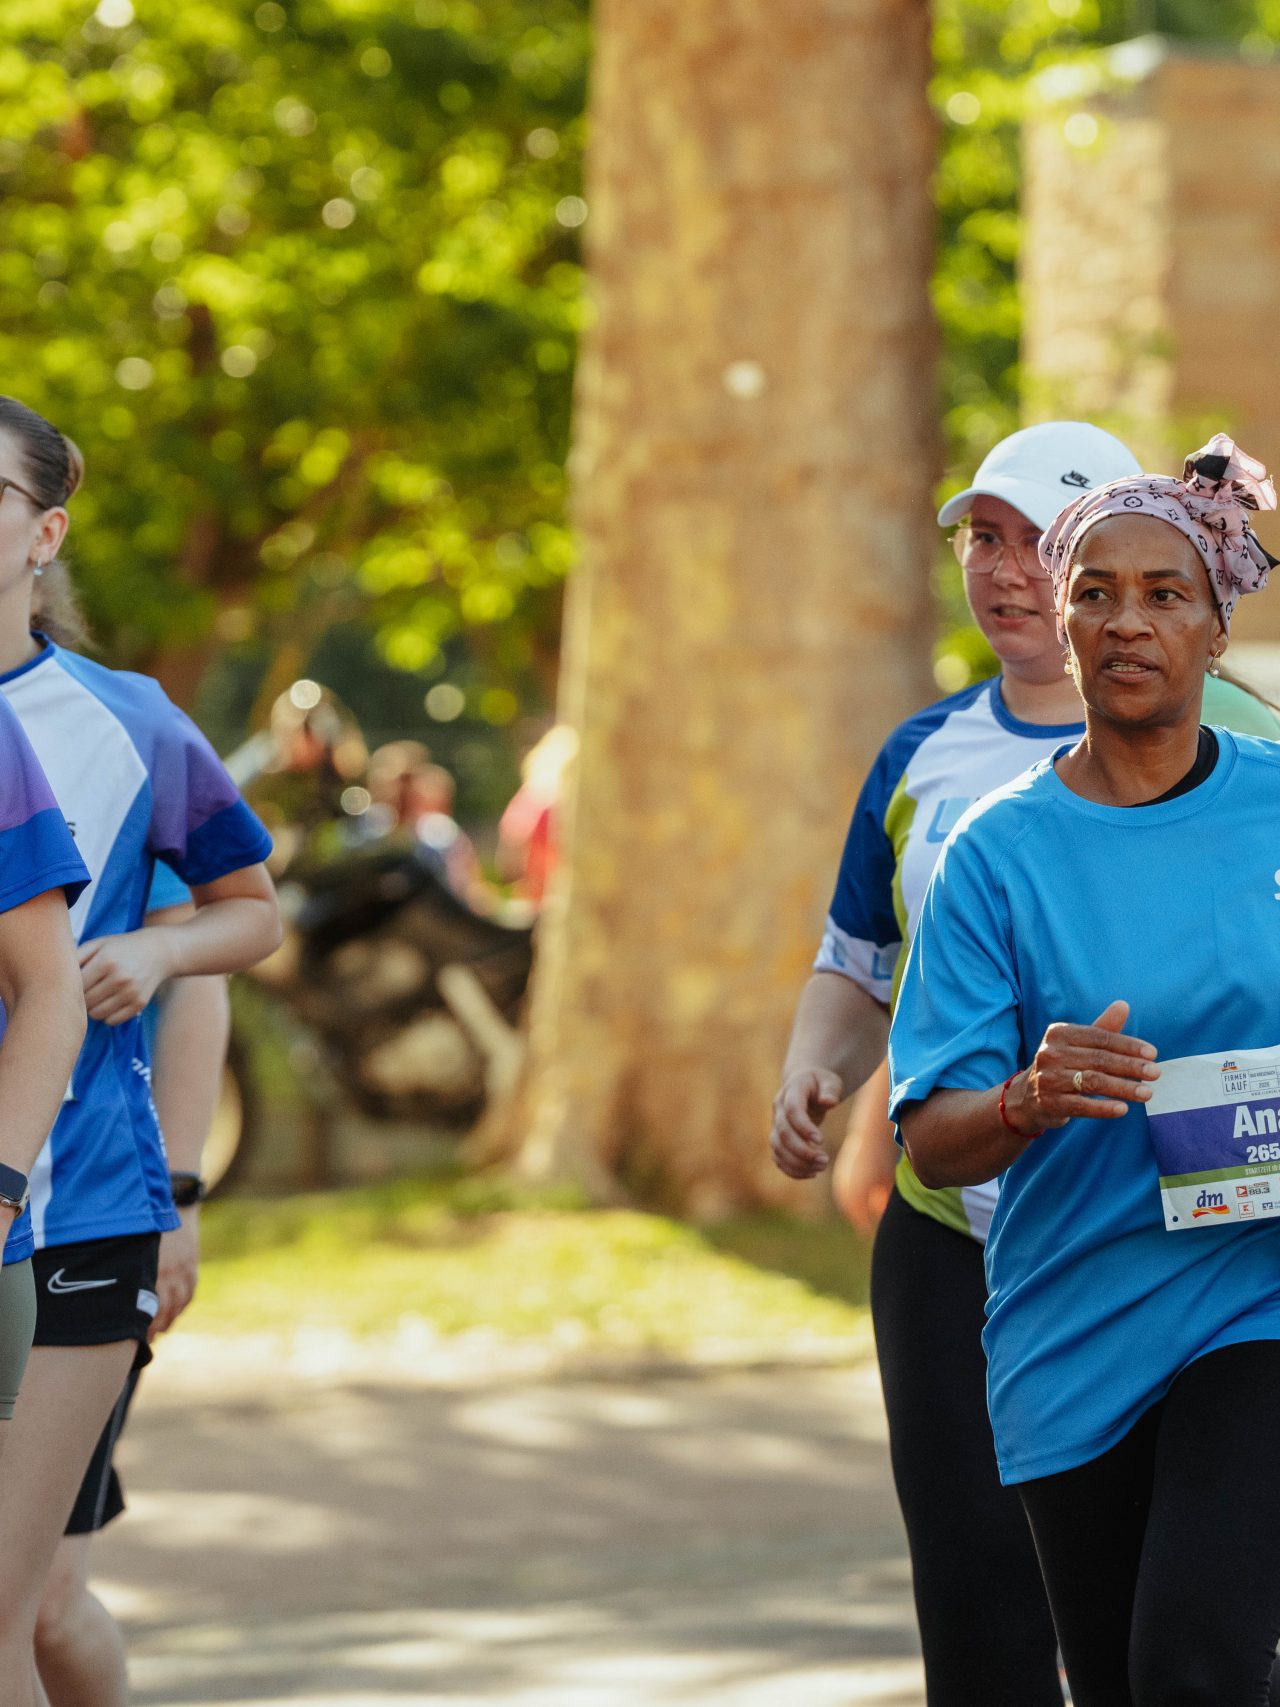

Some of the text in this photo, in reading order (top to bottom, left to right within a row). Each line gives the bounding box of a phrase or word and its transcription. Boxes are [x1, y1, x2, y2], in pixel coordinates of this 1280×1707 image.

[1224, 1073, 1247, 1082] FIRMEN
[1225, 1081, 1248, 1092] LAUF
[1249, 1187, 1271, 1195] 88.3
[1196, 1190, 1223, 1208] dm
